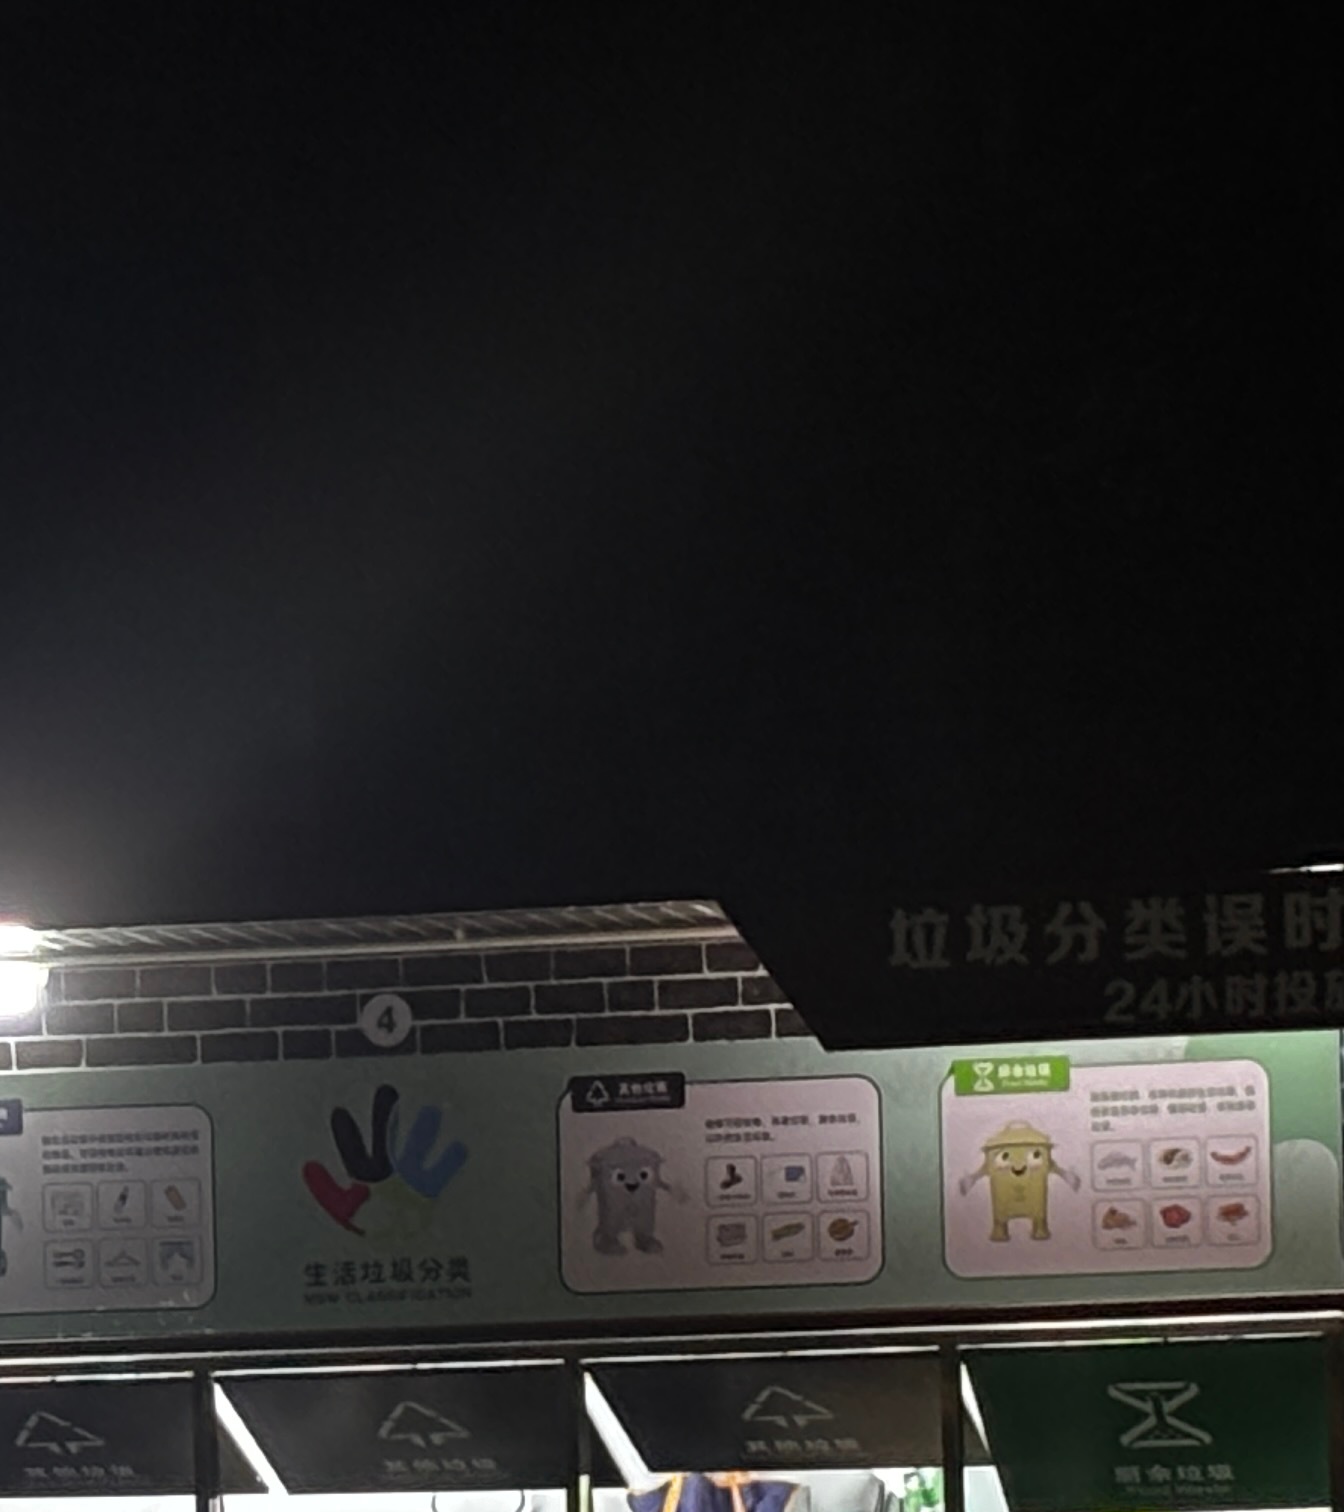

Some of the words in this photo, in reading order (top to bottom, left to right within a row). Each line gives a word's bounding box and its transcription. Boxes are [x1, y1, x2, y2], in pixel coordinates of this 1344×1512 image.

[376, 1004, 399, 1035] 4
[304, 1255, 472, 1287] 生活垃圾分类
